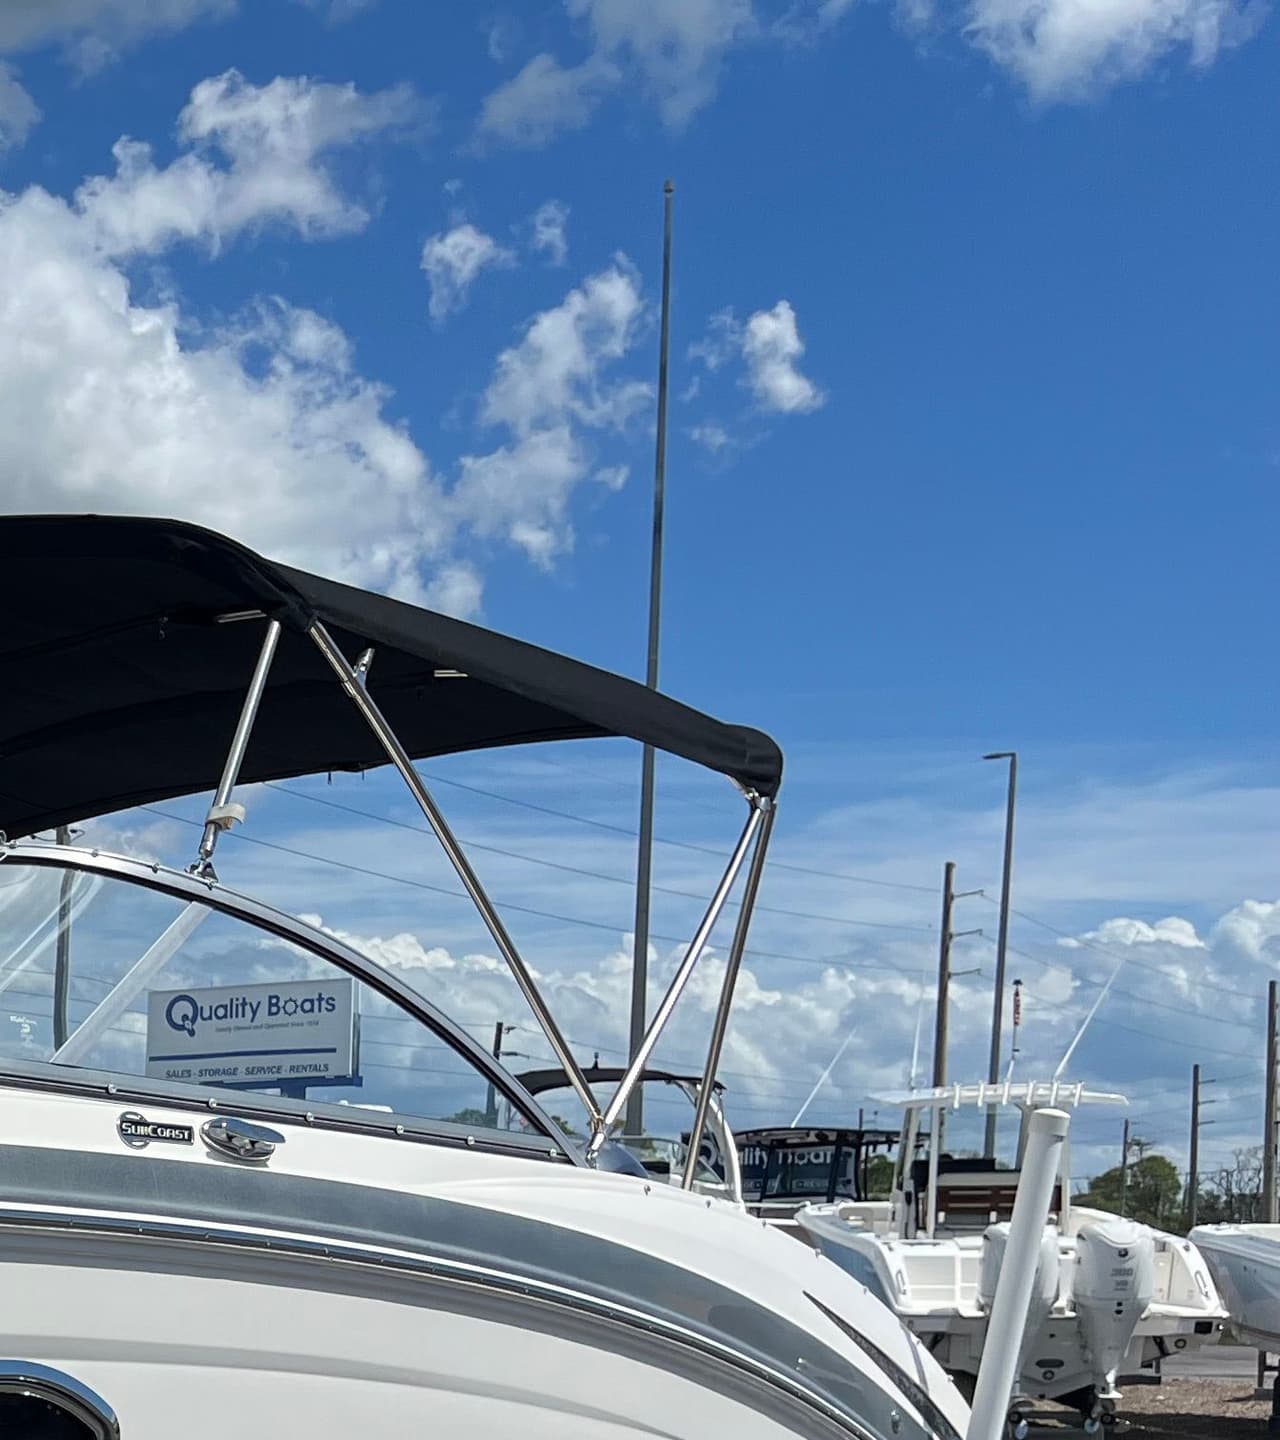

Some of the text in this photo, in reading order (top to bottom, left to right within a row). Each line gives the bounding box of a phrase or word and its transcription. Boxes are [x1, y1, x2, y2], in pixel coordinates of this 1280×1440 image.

[165, 992, 336, 1037] Quality Boats
[165, 1063, 329, 1079] SALES STORAGE SERVICE RENTALS
